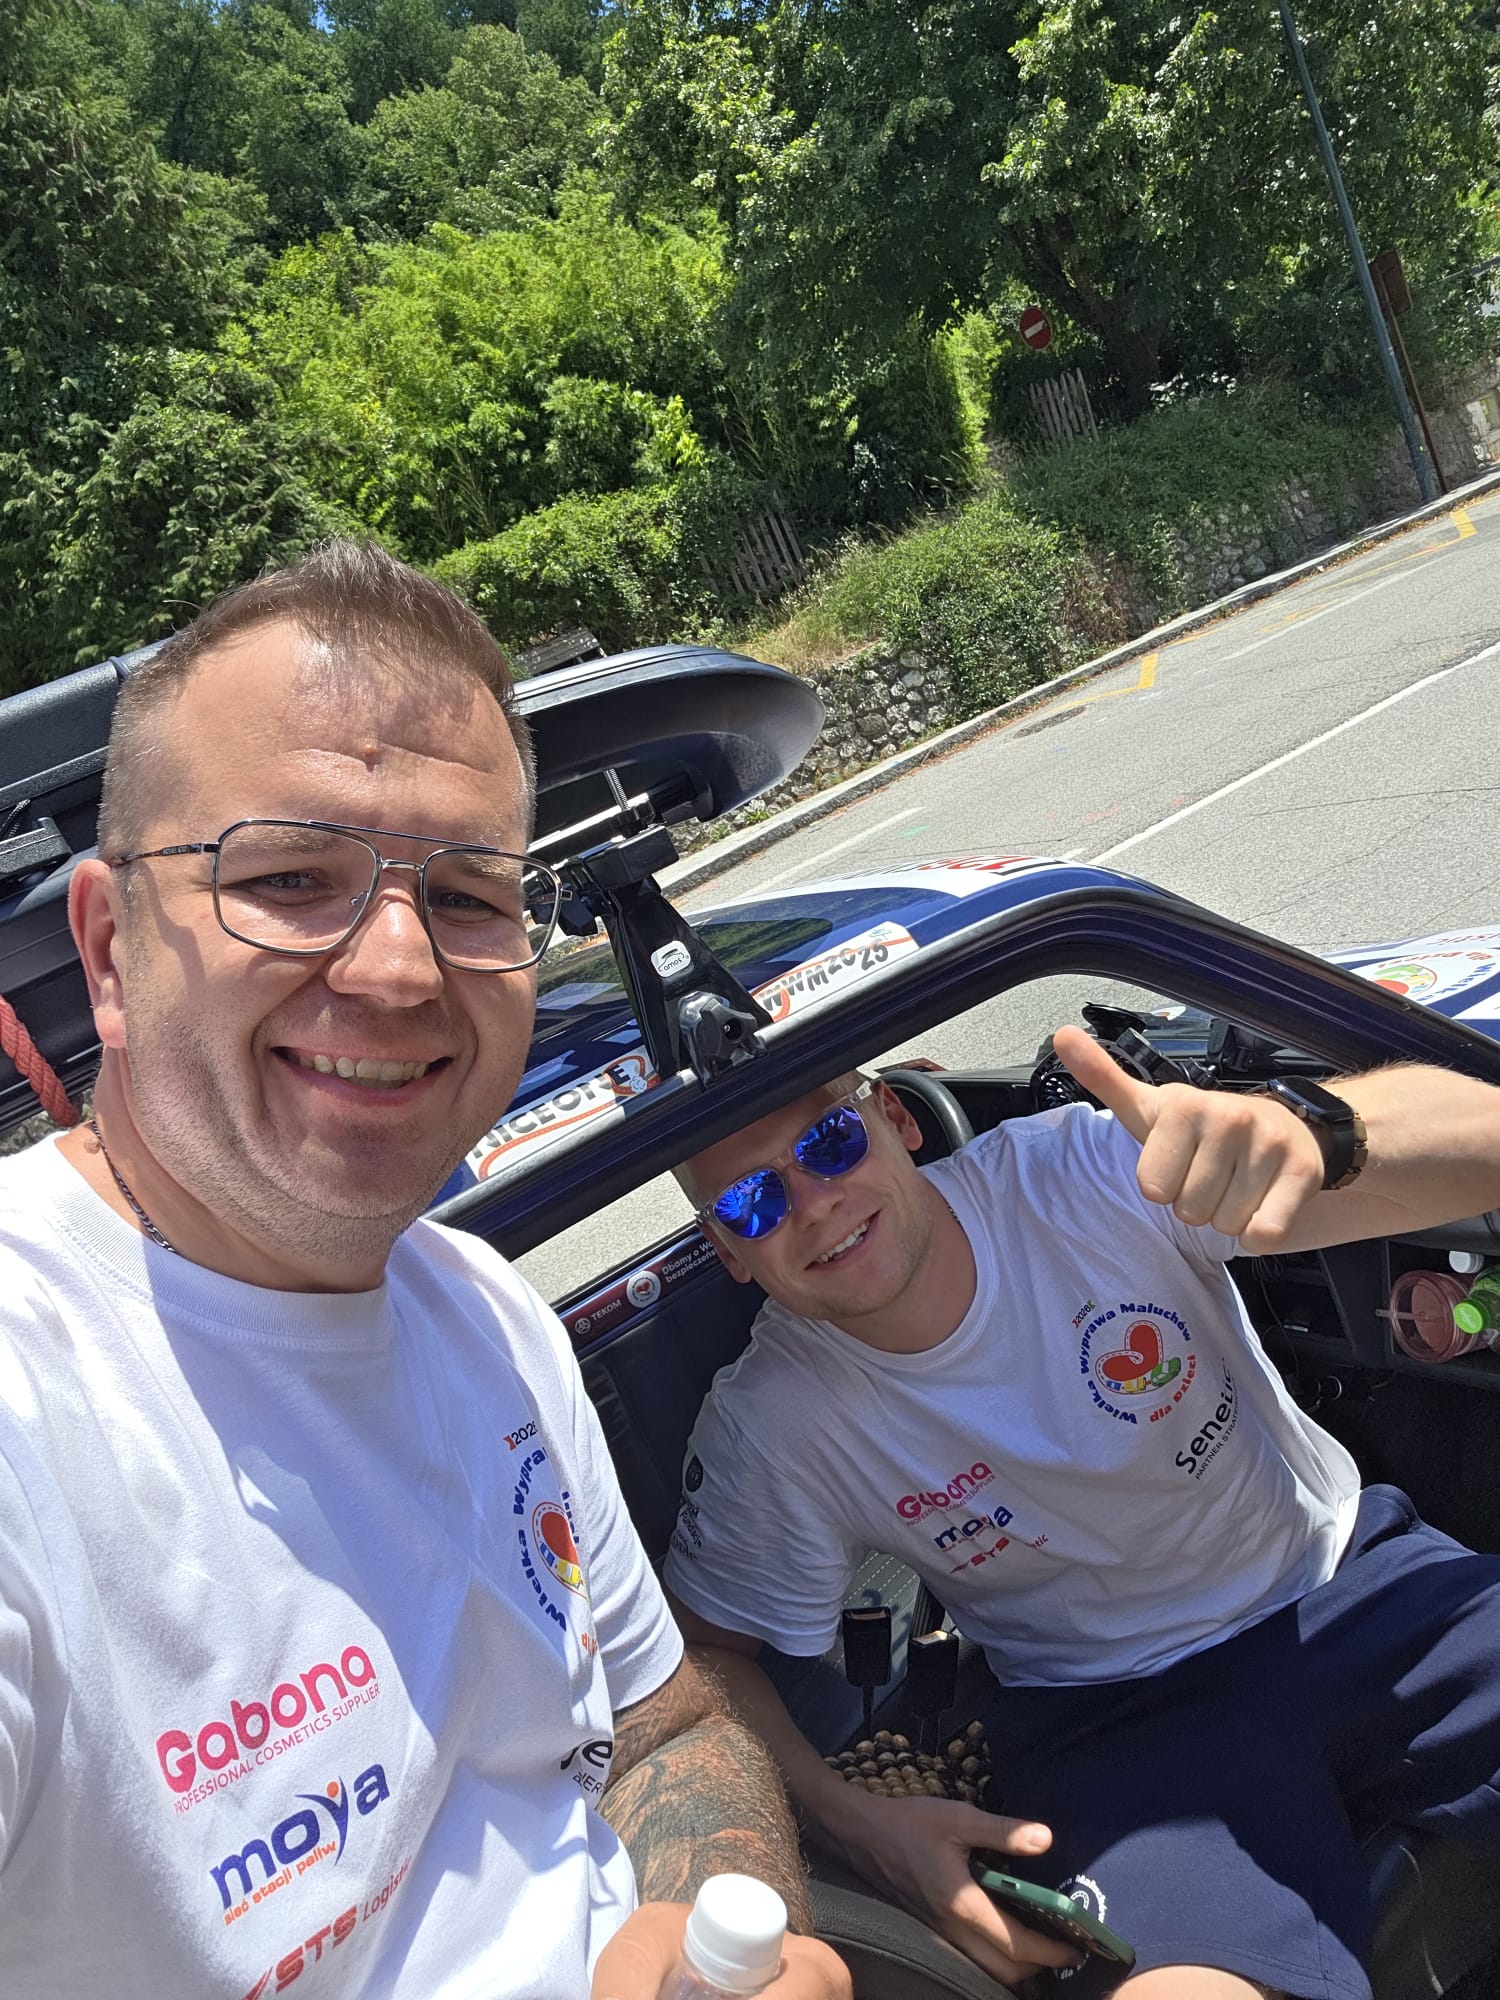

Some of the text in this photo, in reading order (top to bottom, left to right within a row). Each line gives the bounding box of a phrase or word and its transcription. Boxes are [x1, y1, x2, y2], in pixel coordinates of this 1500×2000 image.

[758, 938, 889, 1011] WWM2025
[661, 1253, 692, 1275] Dbamy
[693, 1249, 700, 1257] o
[591, 1299, 622, 1322] TEKOM
[1080, 1303, 1191, 1425] Wielka Wyprawa Maluchów
[1149, 1354, 1196, 1422] dla Dzieci
[1195, 1441, 1224, 1480] PARTNER
[513, 1447, 567, 1632] Wielka Wypra
[156, 1646, 376, 1793] Gabona
[174, 1683, 380, 1815] PROFESSIONAL COSMETICS SUPPLIER
[209, 1764, 390, 1910] moya
[224, 1841, 336, 1925] sieć stacji paliw
[276, 1905, 357, 1994] STS
